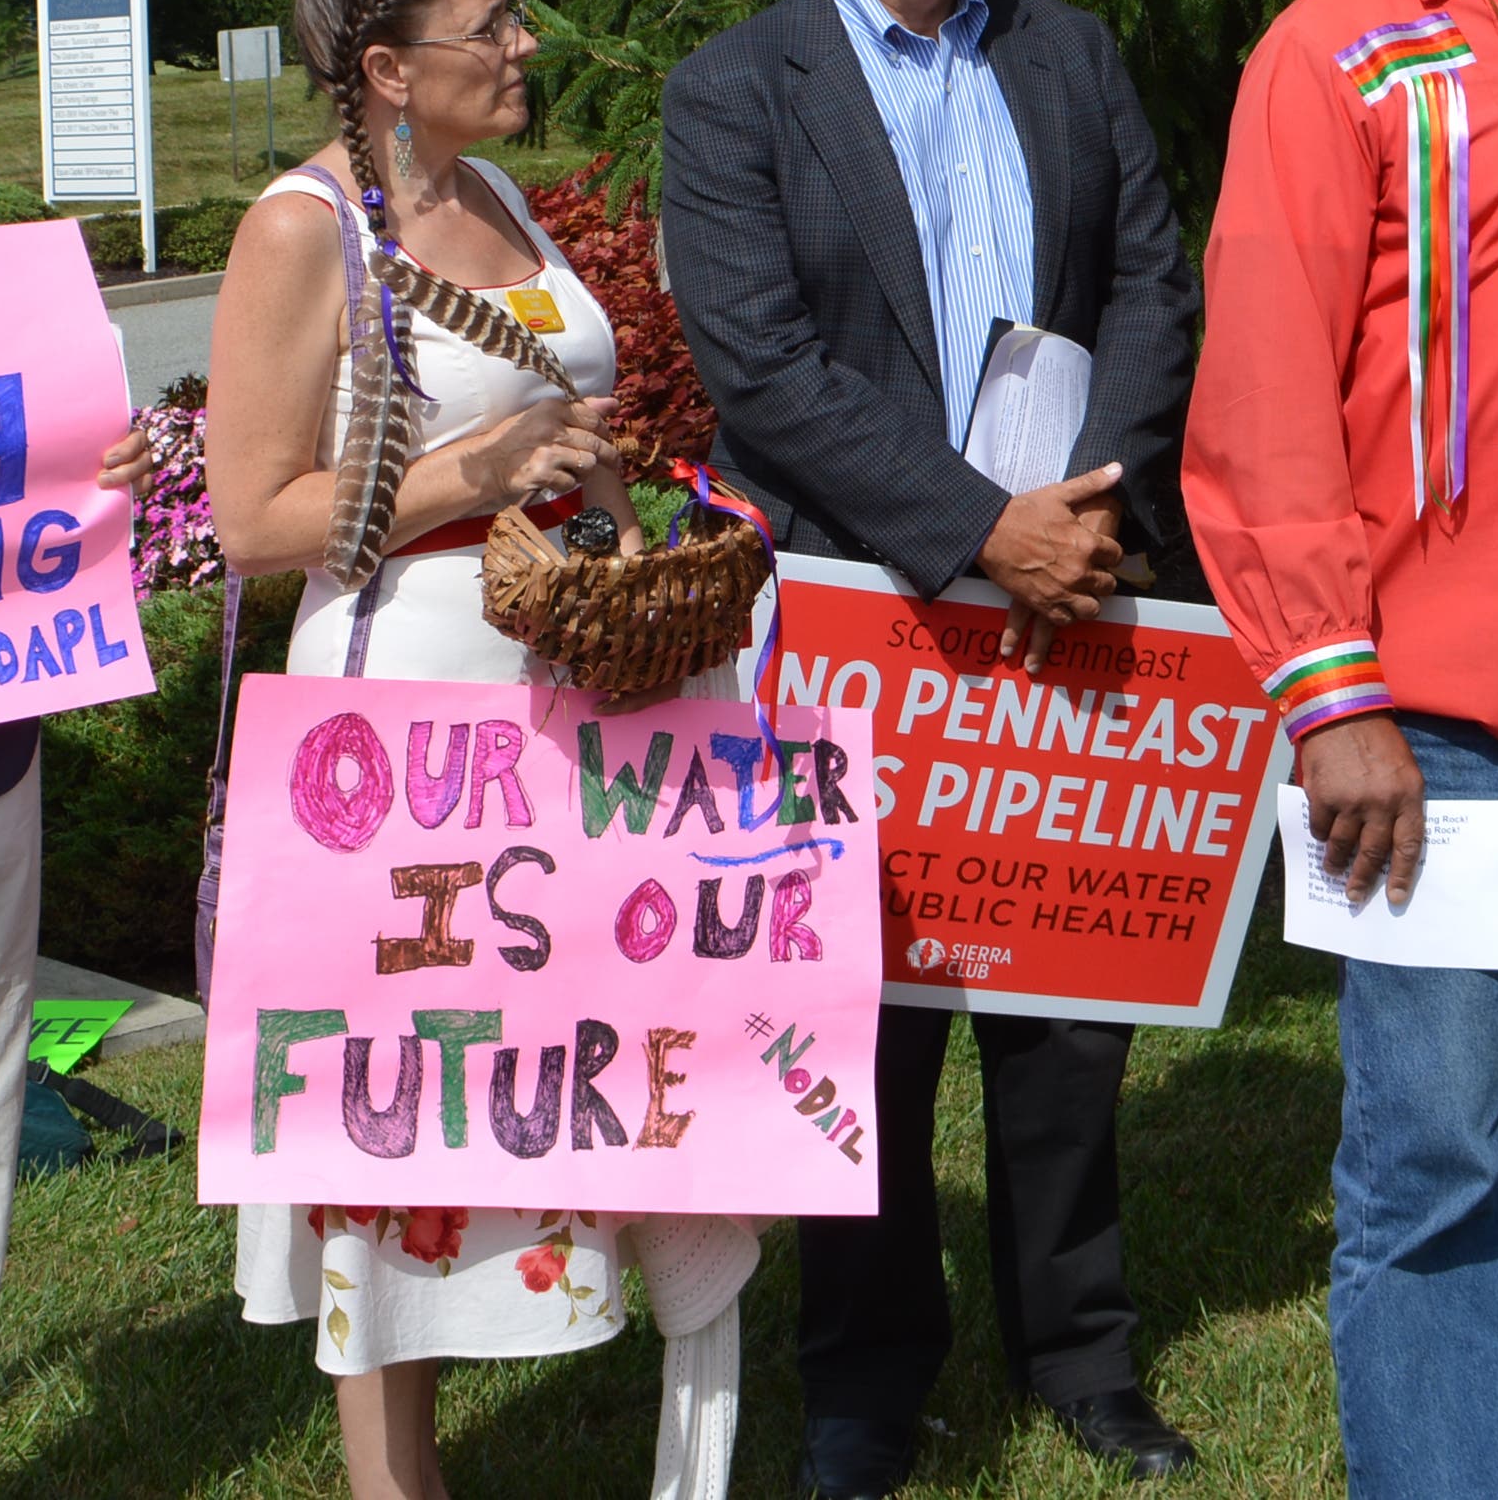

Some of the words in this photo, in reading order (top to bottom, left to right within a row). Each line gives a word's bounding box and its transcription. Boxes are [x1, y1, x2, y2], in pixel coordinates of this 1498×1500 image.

[777, 651, 882, 714] NO
[896, 665, 1268, 772] PENNEAST
[289, 712, 535, 854] OUR
[576, 721, 860, 839] WATER
[917, 760, 1243, 857] PIPELINE
[371, 845, 557, 975] IS
[614, 868, 823, 964] OUR
[885, 887, 1017, 927] UBLIC
[1032, 901, 1196, 942] HEALTH
[956, 856, 1049, 892] OUR
[1067, 866, 1212, 906] WATER
[945, 960, 990, 980] CLUB
[950, 942, 1013, 965] SIERRA
[252, 1008, 698, 1160] FUTURE
